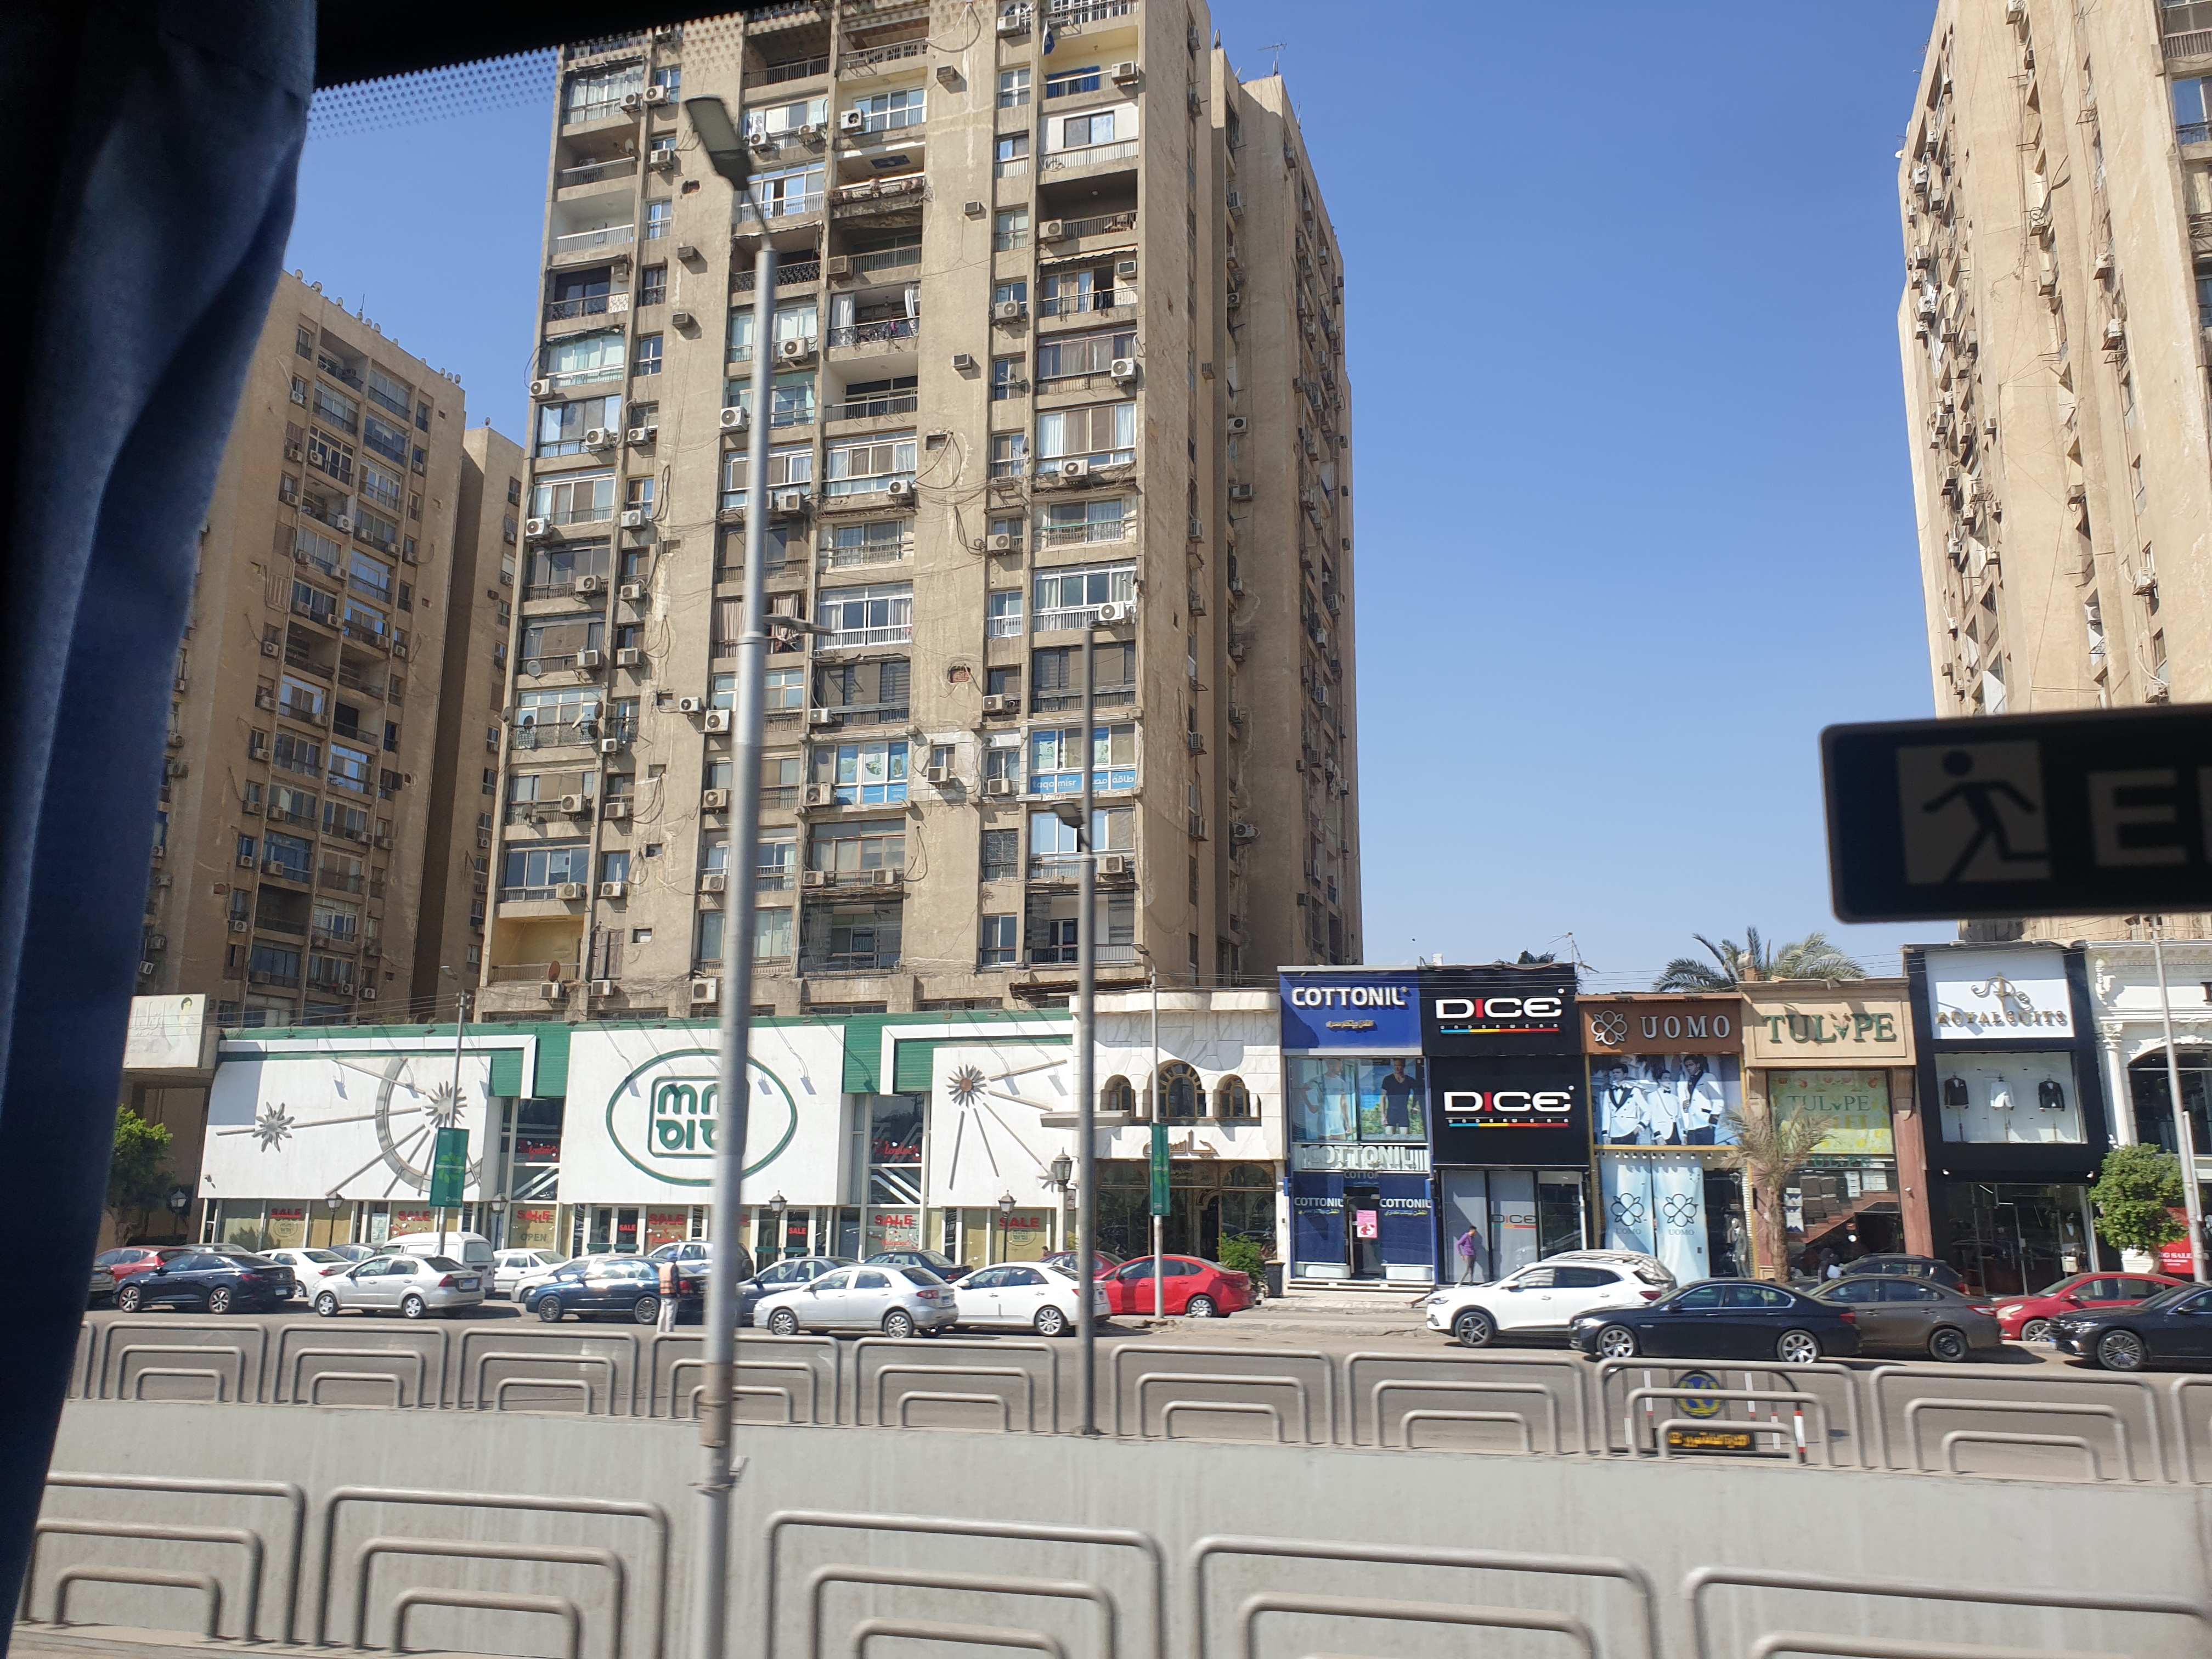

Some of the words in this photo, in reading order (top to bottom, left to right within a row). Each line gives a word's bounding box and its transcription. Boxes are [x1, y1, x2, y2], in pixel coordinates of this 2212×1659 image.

[1058, 777, 1077, 787] misr
[1112, 774, 1134, 783] طاقة
[1292, 987, 1405, 1006] COTTONIL
[1436, 997, 1562, 1018] DICE
[1936, 1012, 2002, 1024] ROYAL
[2006, 1010, 2067, 1024] SUITS
[1640, 1015, 1730, 1039] UOMO
[1444, 1091, 1571, 1111] DICE
[1294, 1197, 1344, 1207] COTTONIL
[1379, 1198, 1431, 1208] COTTONIL
[398, 1211, 431, 1221] SALE
[517, 1210, 550, 1221] SALE
[649, 1214, 685, 1225] SALE
[874, 1215, 913, 1226] SALE
[1491, 1214, 1537, 1223] DICE
[999, 1217, 1040, 1228] SALE
